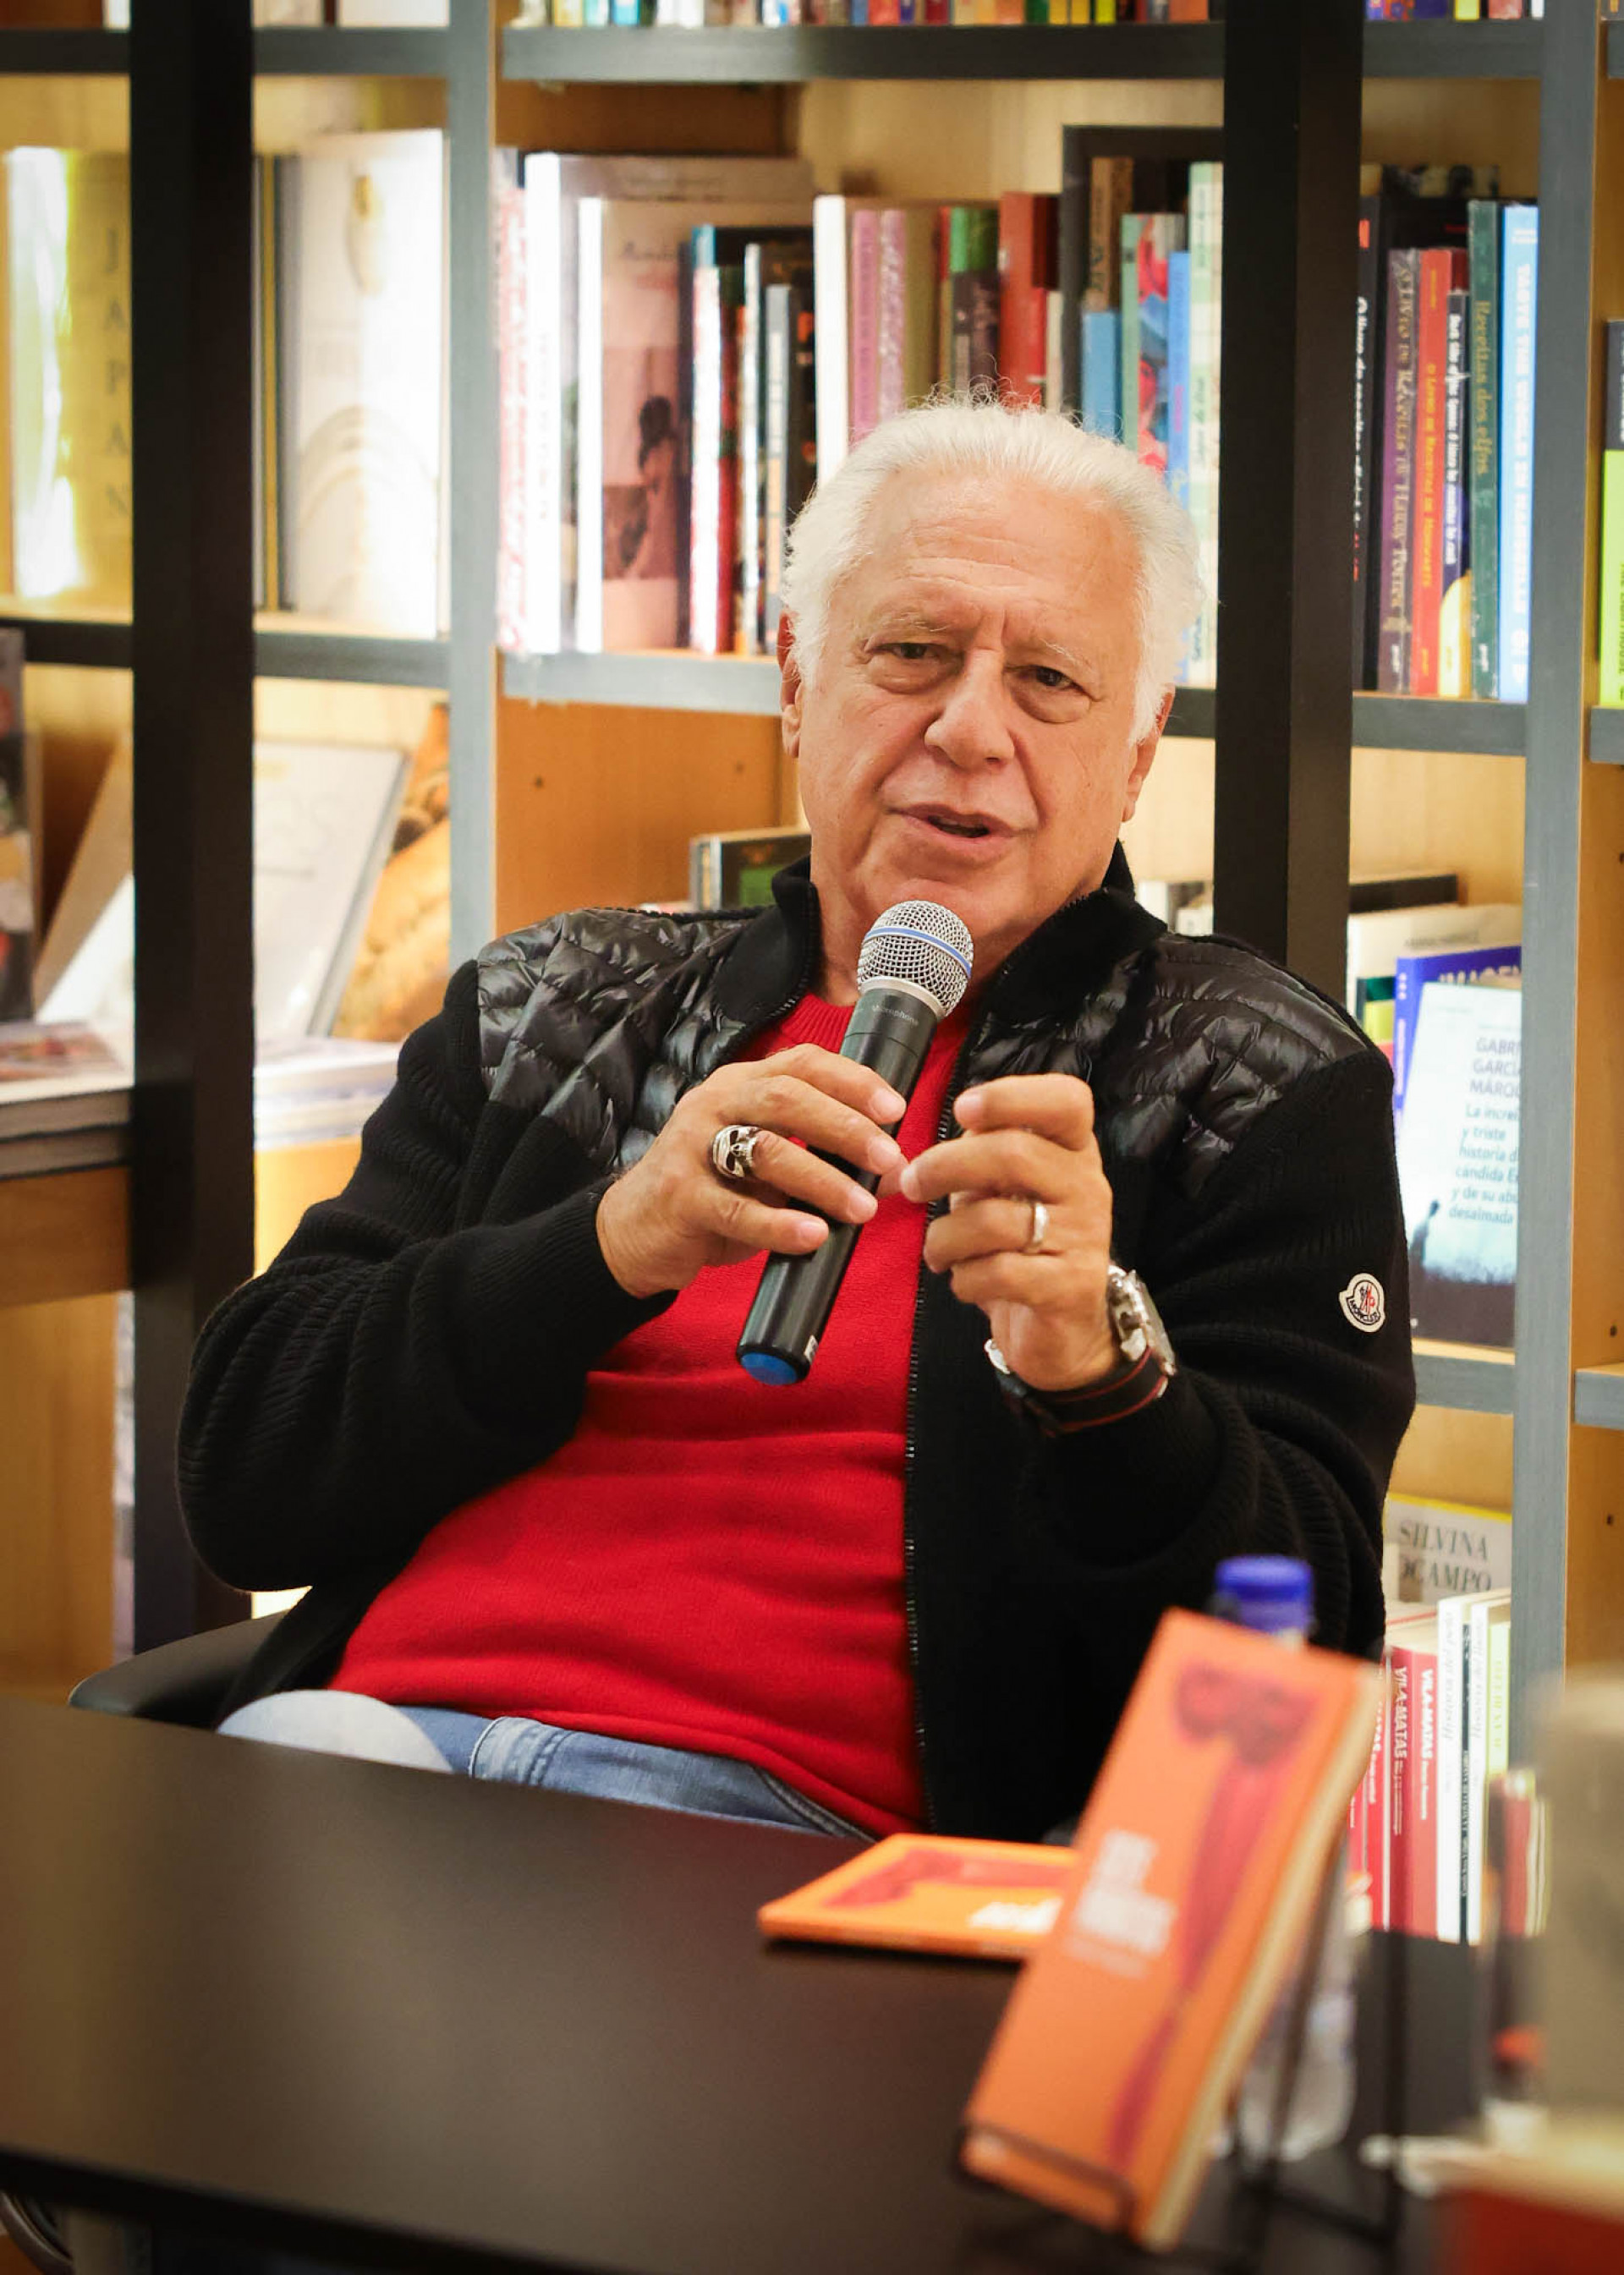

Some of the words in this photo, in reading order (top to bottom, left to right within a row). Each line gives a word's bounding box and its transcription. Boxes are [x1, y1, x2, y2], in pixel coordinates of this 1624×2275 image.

[1462, 1187, 1478, 1199] de
[1481, 1190, 1495, 1202] su
[1400, 1520, 1489, 1562] SILVINA
[1421, 1669, 1434, 1758] VILA-MATAS
